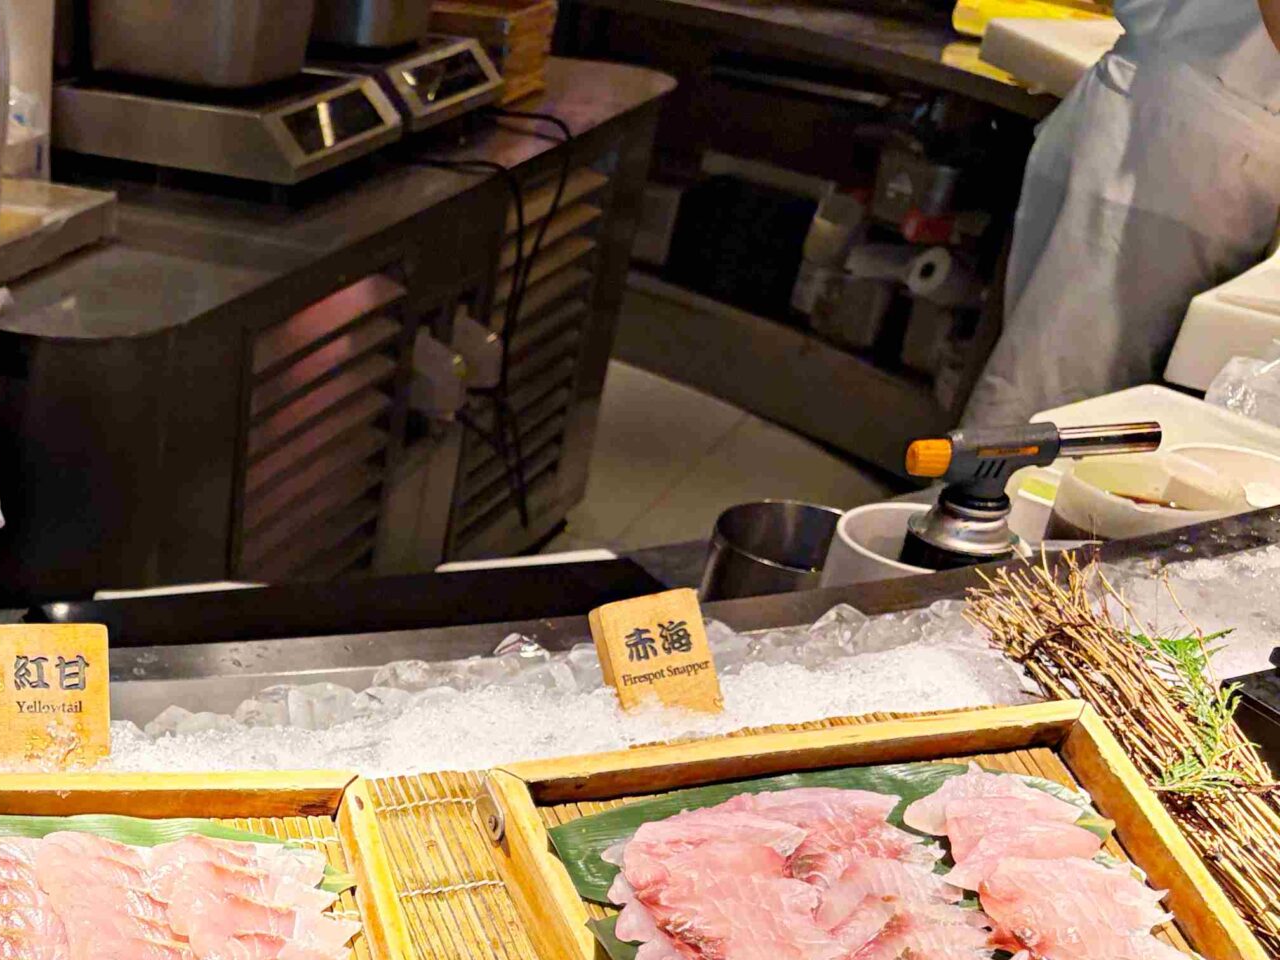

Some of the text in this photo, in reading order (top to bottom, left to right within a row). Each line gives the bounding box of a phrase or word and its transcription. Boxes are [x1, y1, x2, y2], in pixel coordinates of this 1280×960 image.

[624, 620, 692, 662] 赤海
[13, 654, 90, 691] 紅甘
[621, 660, 710, 687] Firespot Snapper
